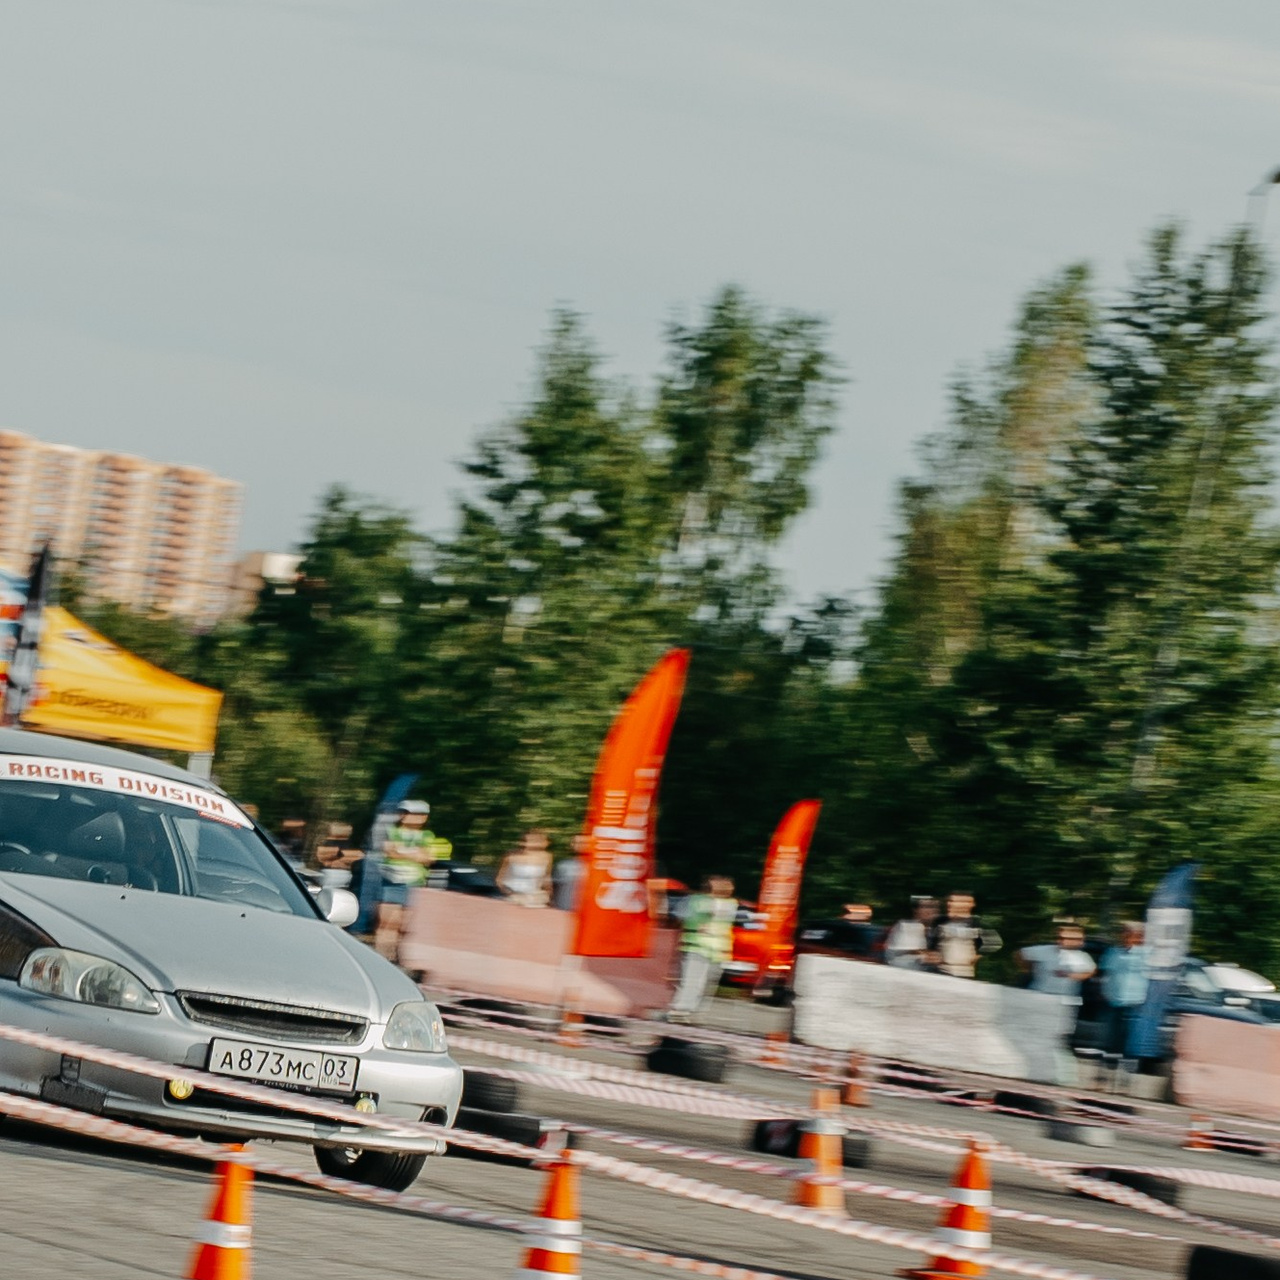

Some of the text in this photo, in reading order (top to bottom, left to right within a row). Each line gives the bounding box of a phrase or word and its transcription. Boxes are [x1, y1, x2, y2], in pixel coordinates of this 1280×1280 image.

[8, 762, 104, 785] RACING
[118, 776, 225, 813] DIVISION
[324, 1058, 348, 1079] 03
